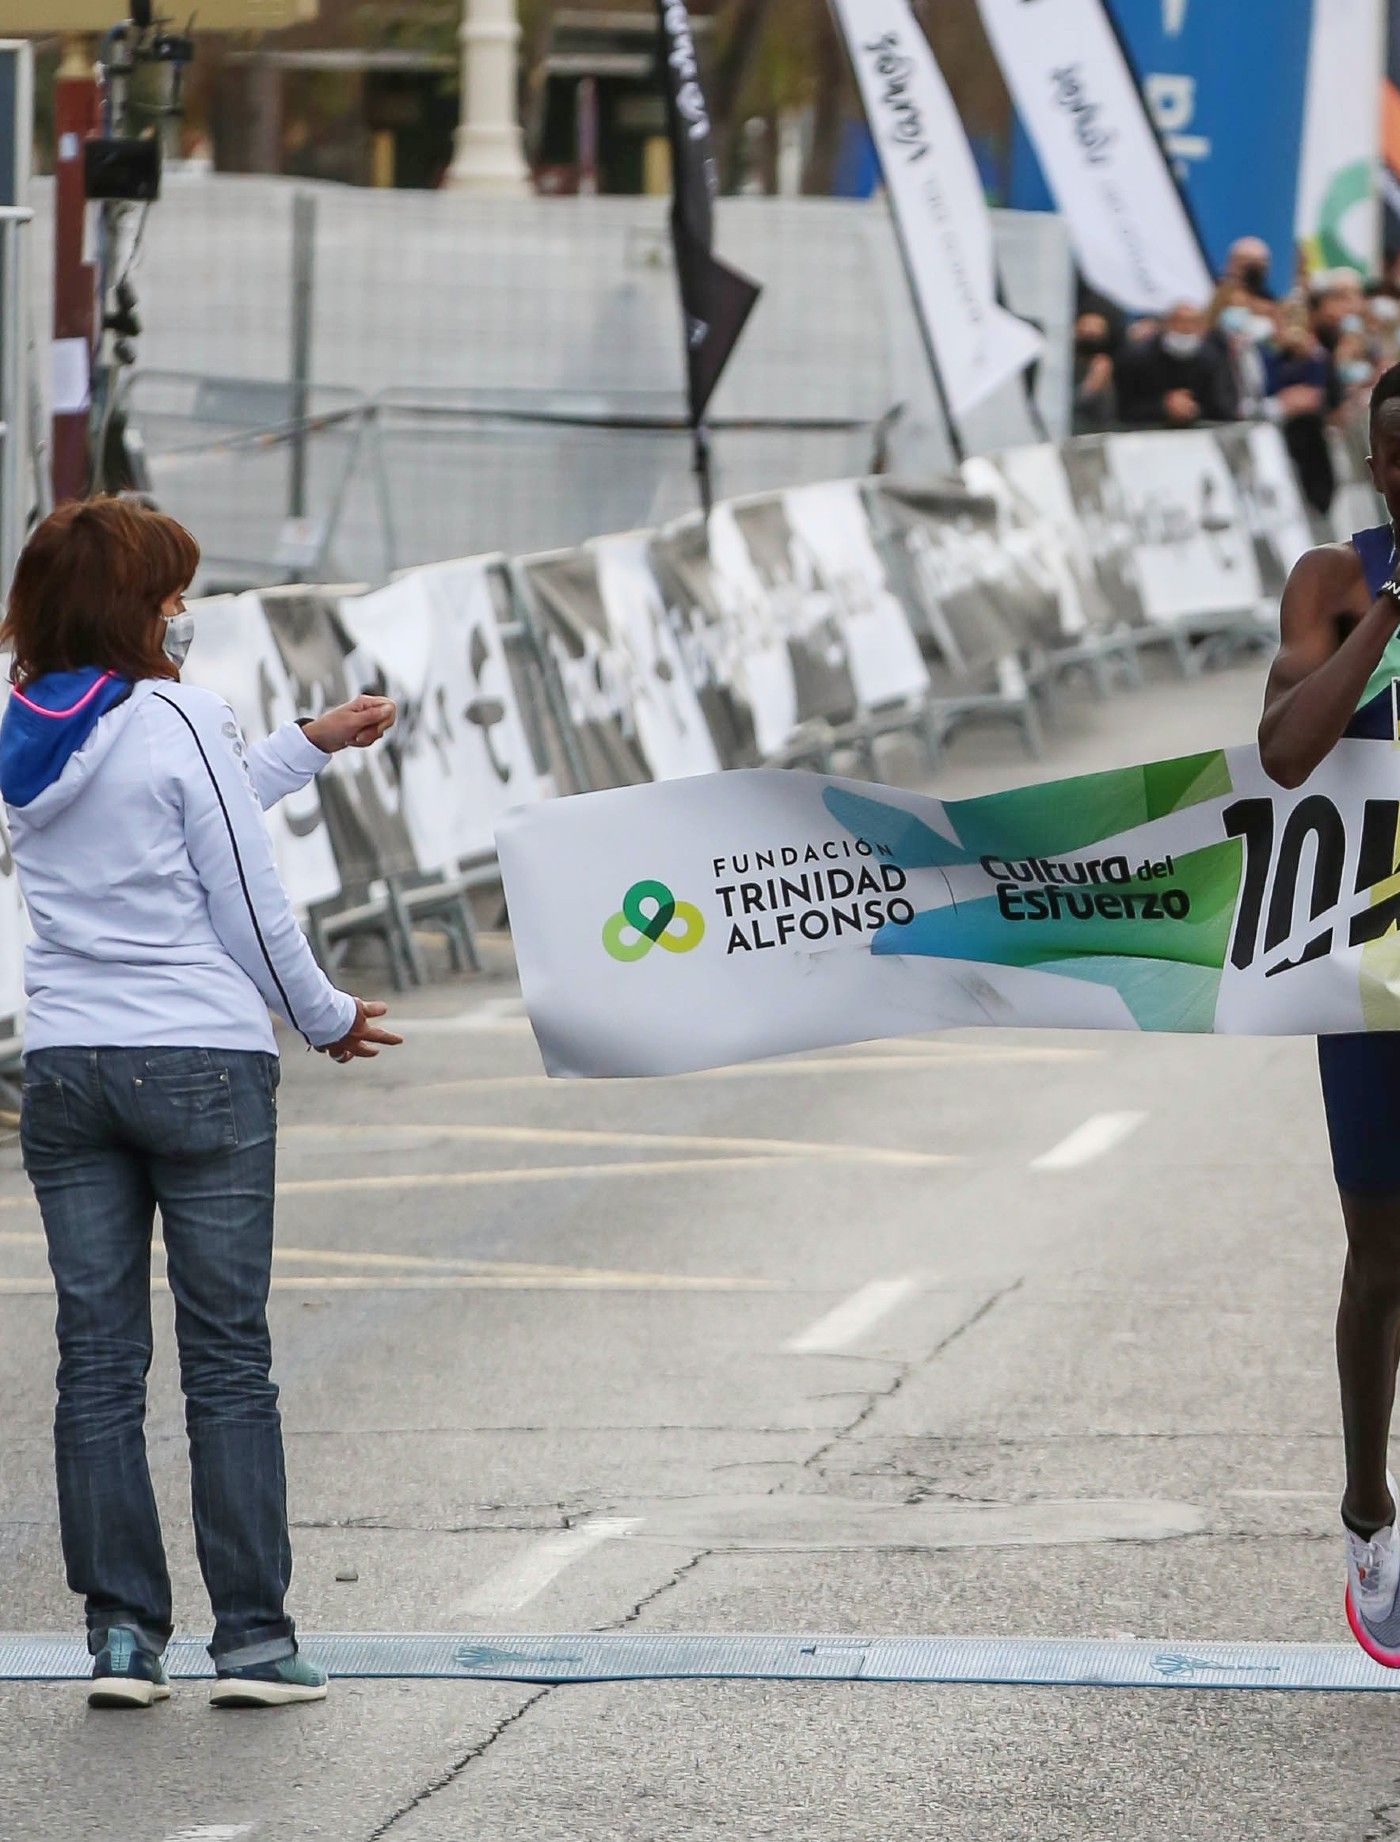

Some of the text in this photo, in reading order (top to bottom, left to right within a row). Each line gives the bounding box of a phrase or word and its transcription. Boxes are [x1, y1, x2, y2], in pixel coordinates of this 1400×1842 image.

[713, 837, 894, 878] FUNDACIÓN
[980, 855, 1175, 885] Cultura del
[715, 863, 907, 918] TRINIDAD
[996, 882, 1191, 922] Esfuerzo
[727, 897, 915, 955] ALFONSO
